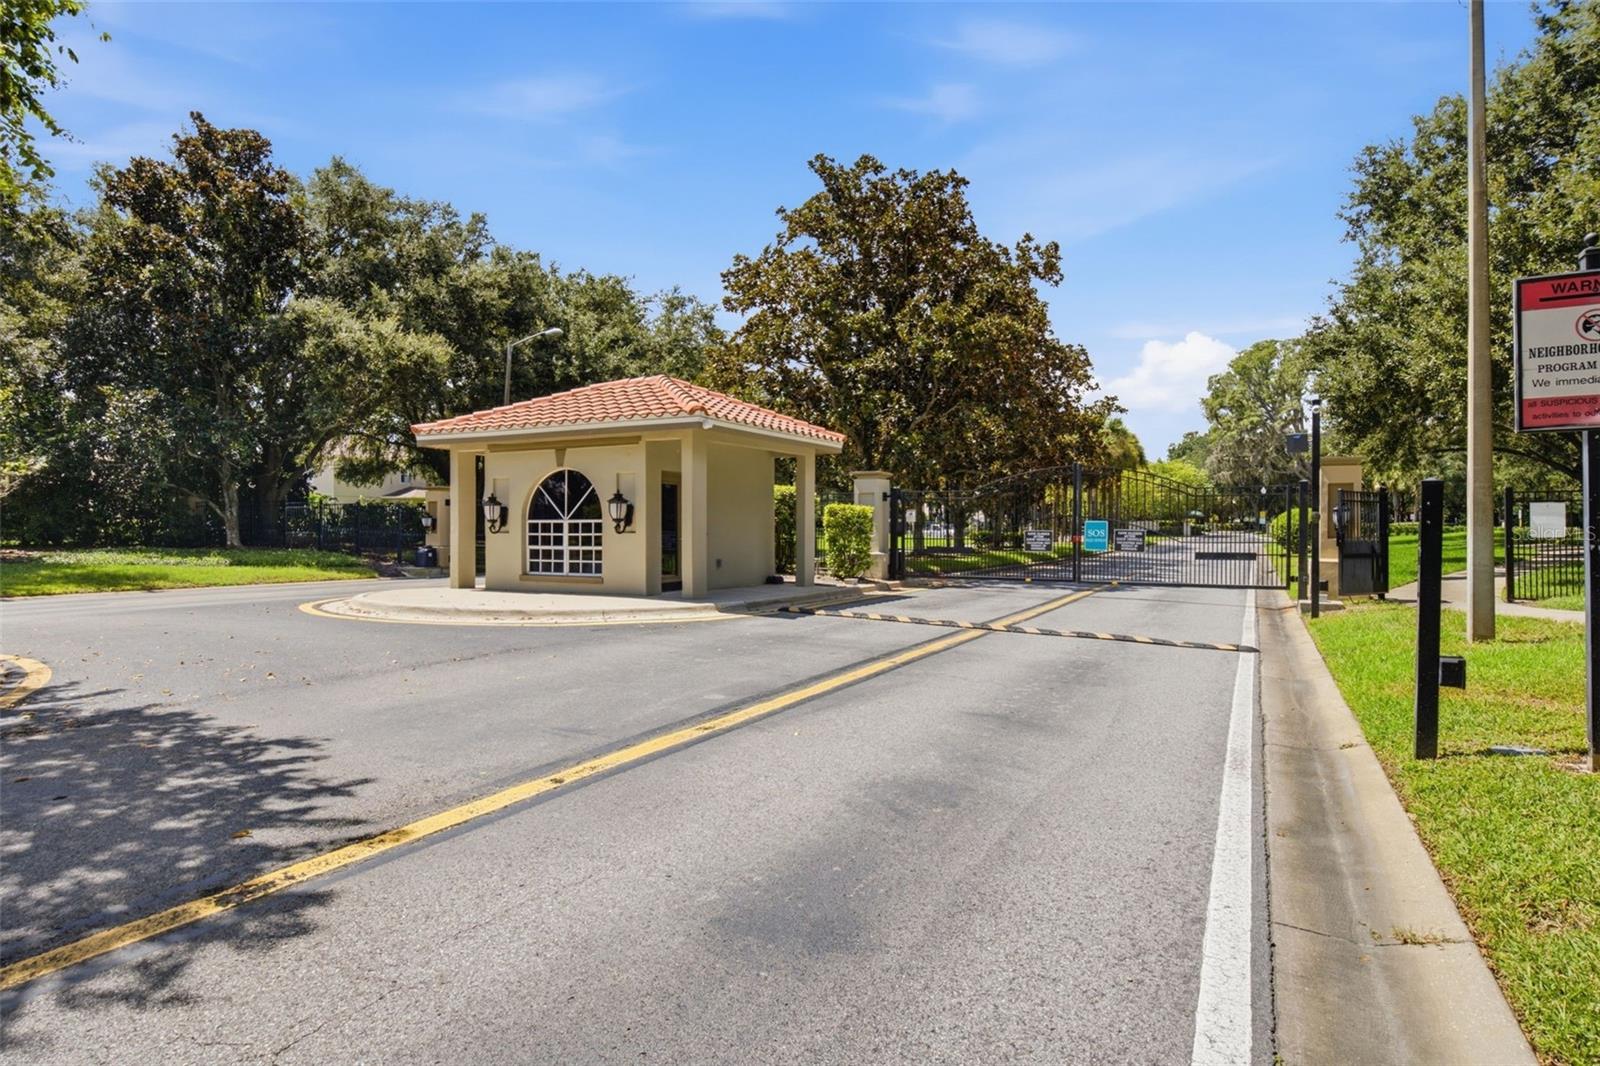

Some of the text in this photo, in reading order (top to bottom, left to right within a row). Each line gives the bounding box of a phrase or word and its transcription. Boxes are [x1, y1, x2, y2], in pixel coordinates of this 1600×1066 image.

[1537, 361, 1598, 373] PROGRAM
[1532, 378, 1551, 387] We
[1540, 397, 1598, 408] SUSPICIOUS
[1532, 411, 1569, 420] activities
[1572, 410, 1581, 418] to
[1087, 528, 1105, 538] SOS
